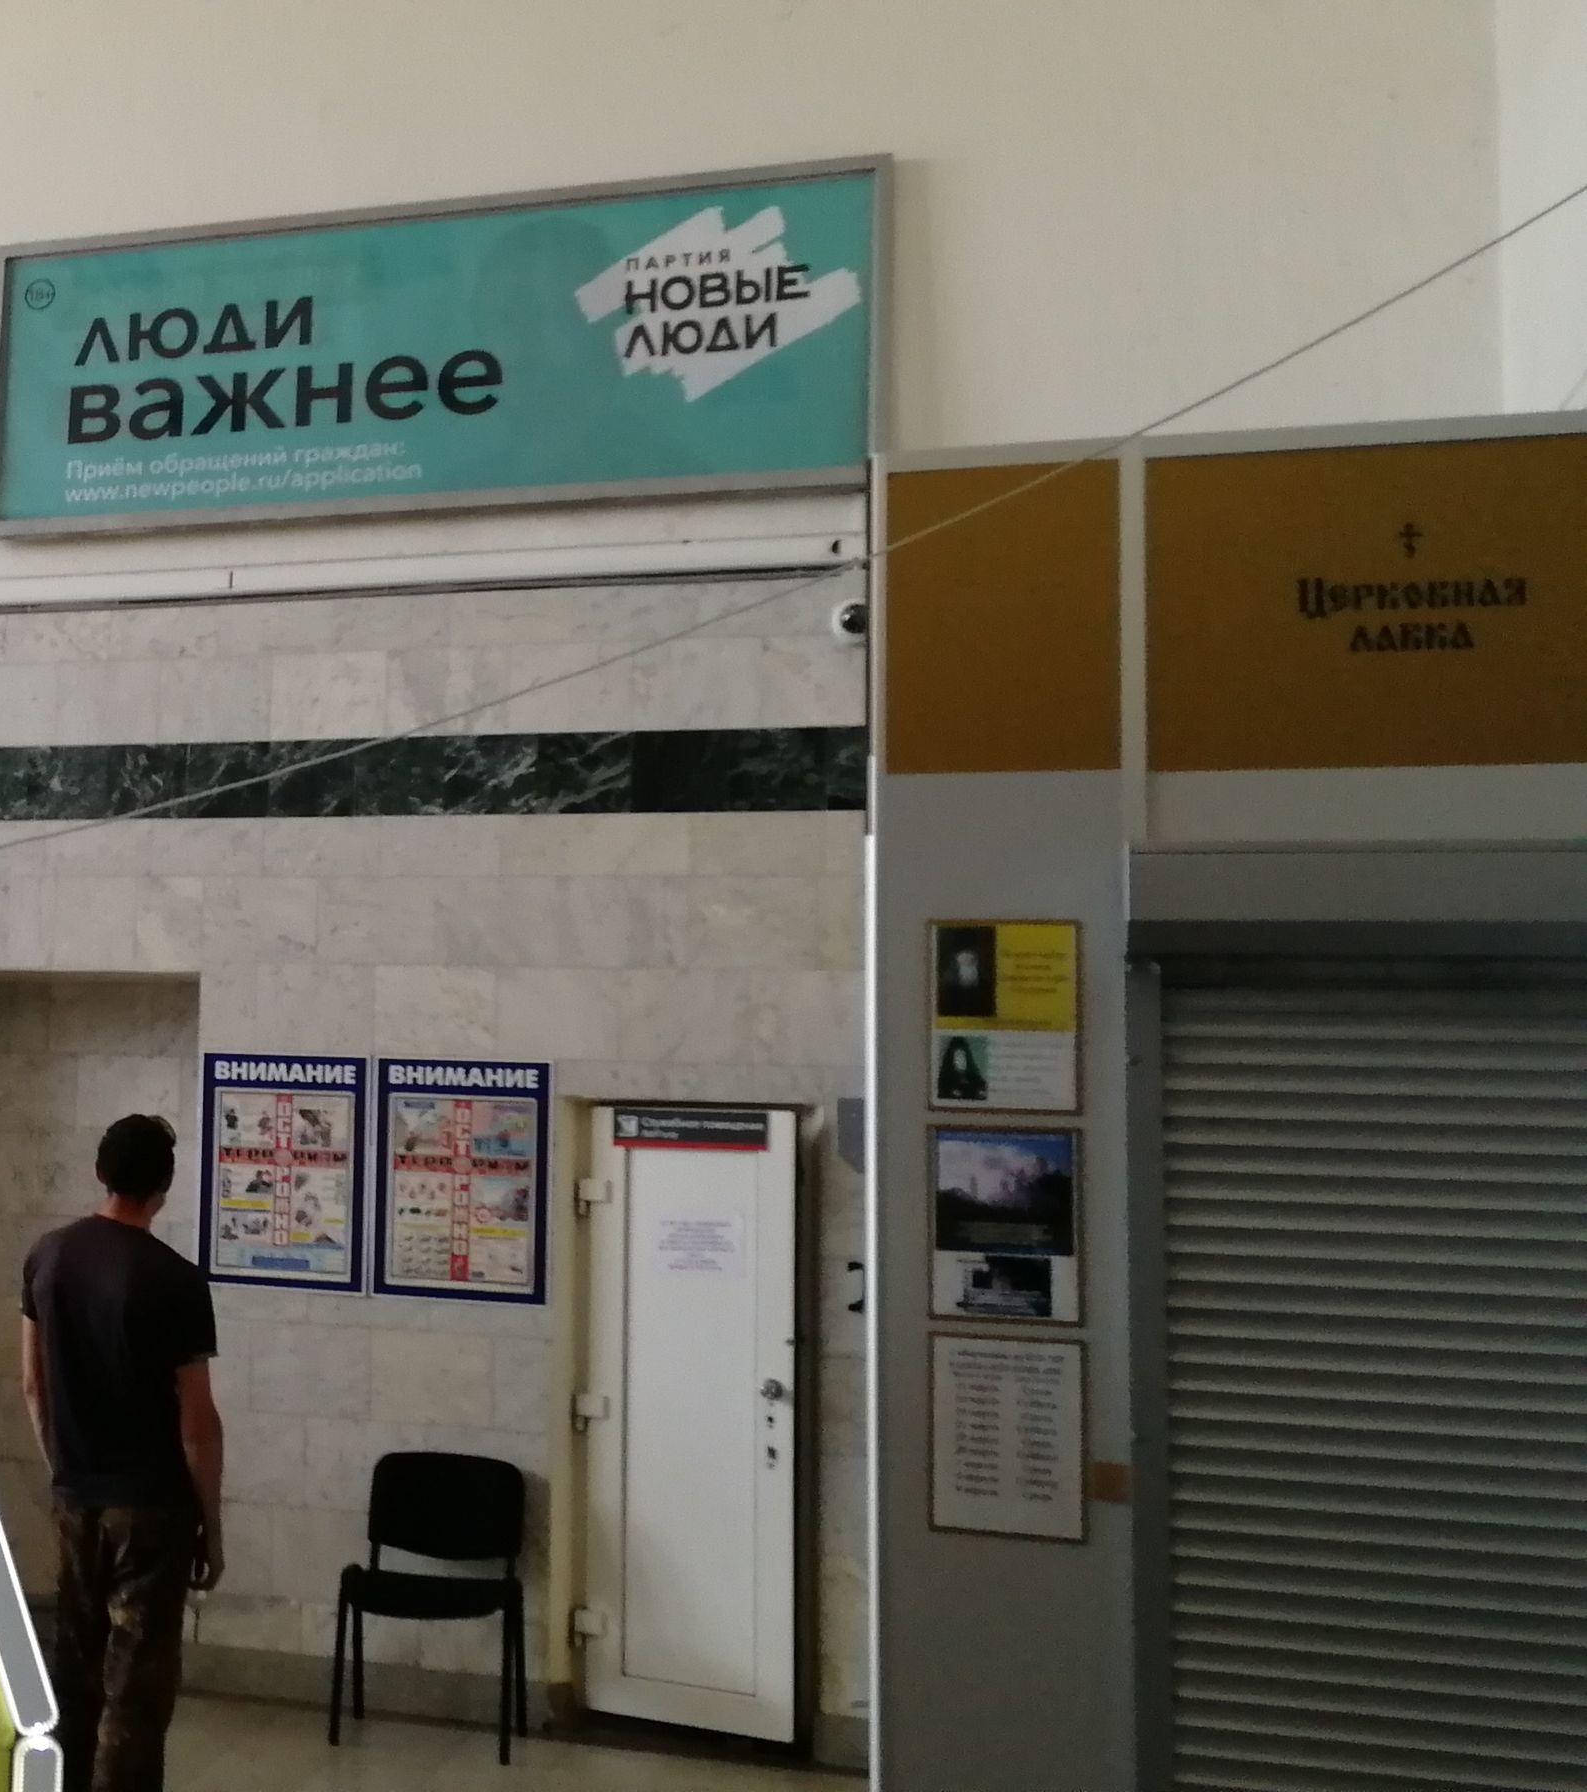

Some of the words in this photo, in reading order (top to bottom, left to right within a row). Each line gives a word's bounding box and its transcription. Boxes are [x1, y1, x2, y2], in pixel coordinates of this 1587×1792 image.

[626, 249, 731, 272] ПАРТИЯ
[625, 264, 811, 315] НОВЫЕ
[625, 312, 778, 358] ЛЮДИ
[68, 349, 504, 445] важнее
[66, 458, 145, 481] Приём
[150, 447, 290, 478] обращений
[294, 440, 405, 466] граждан:
[64, 462, 422, 504] www.newpeople.ru/application
[214, 1060, 357, 1085] ВНИМАНИЕ
[388, 1064, 539, 1089] ВНИМАНИЕ
